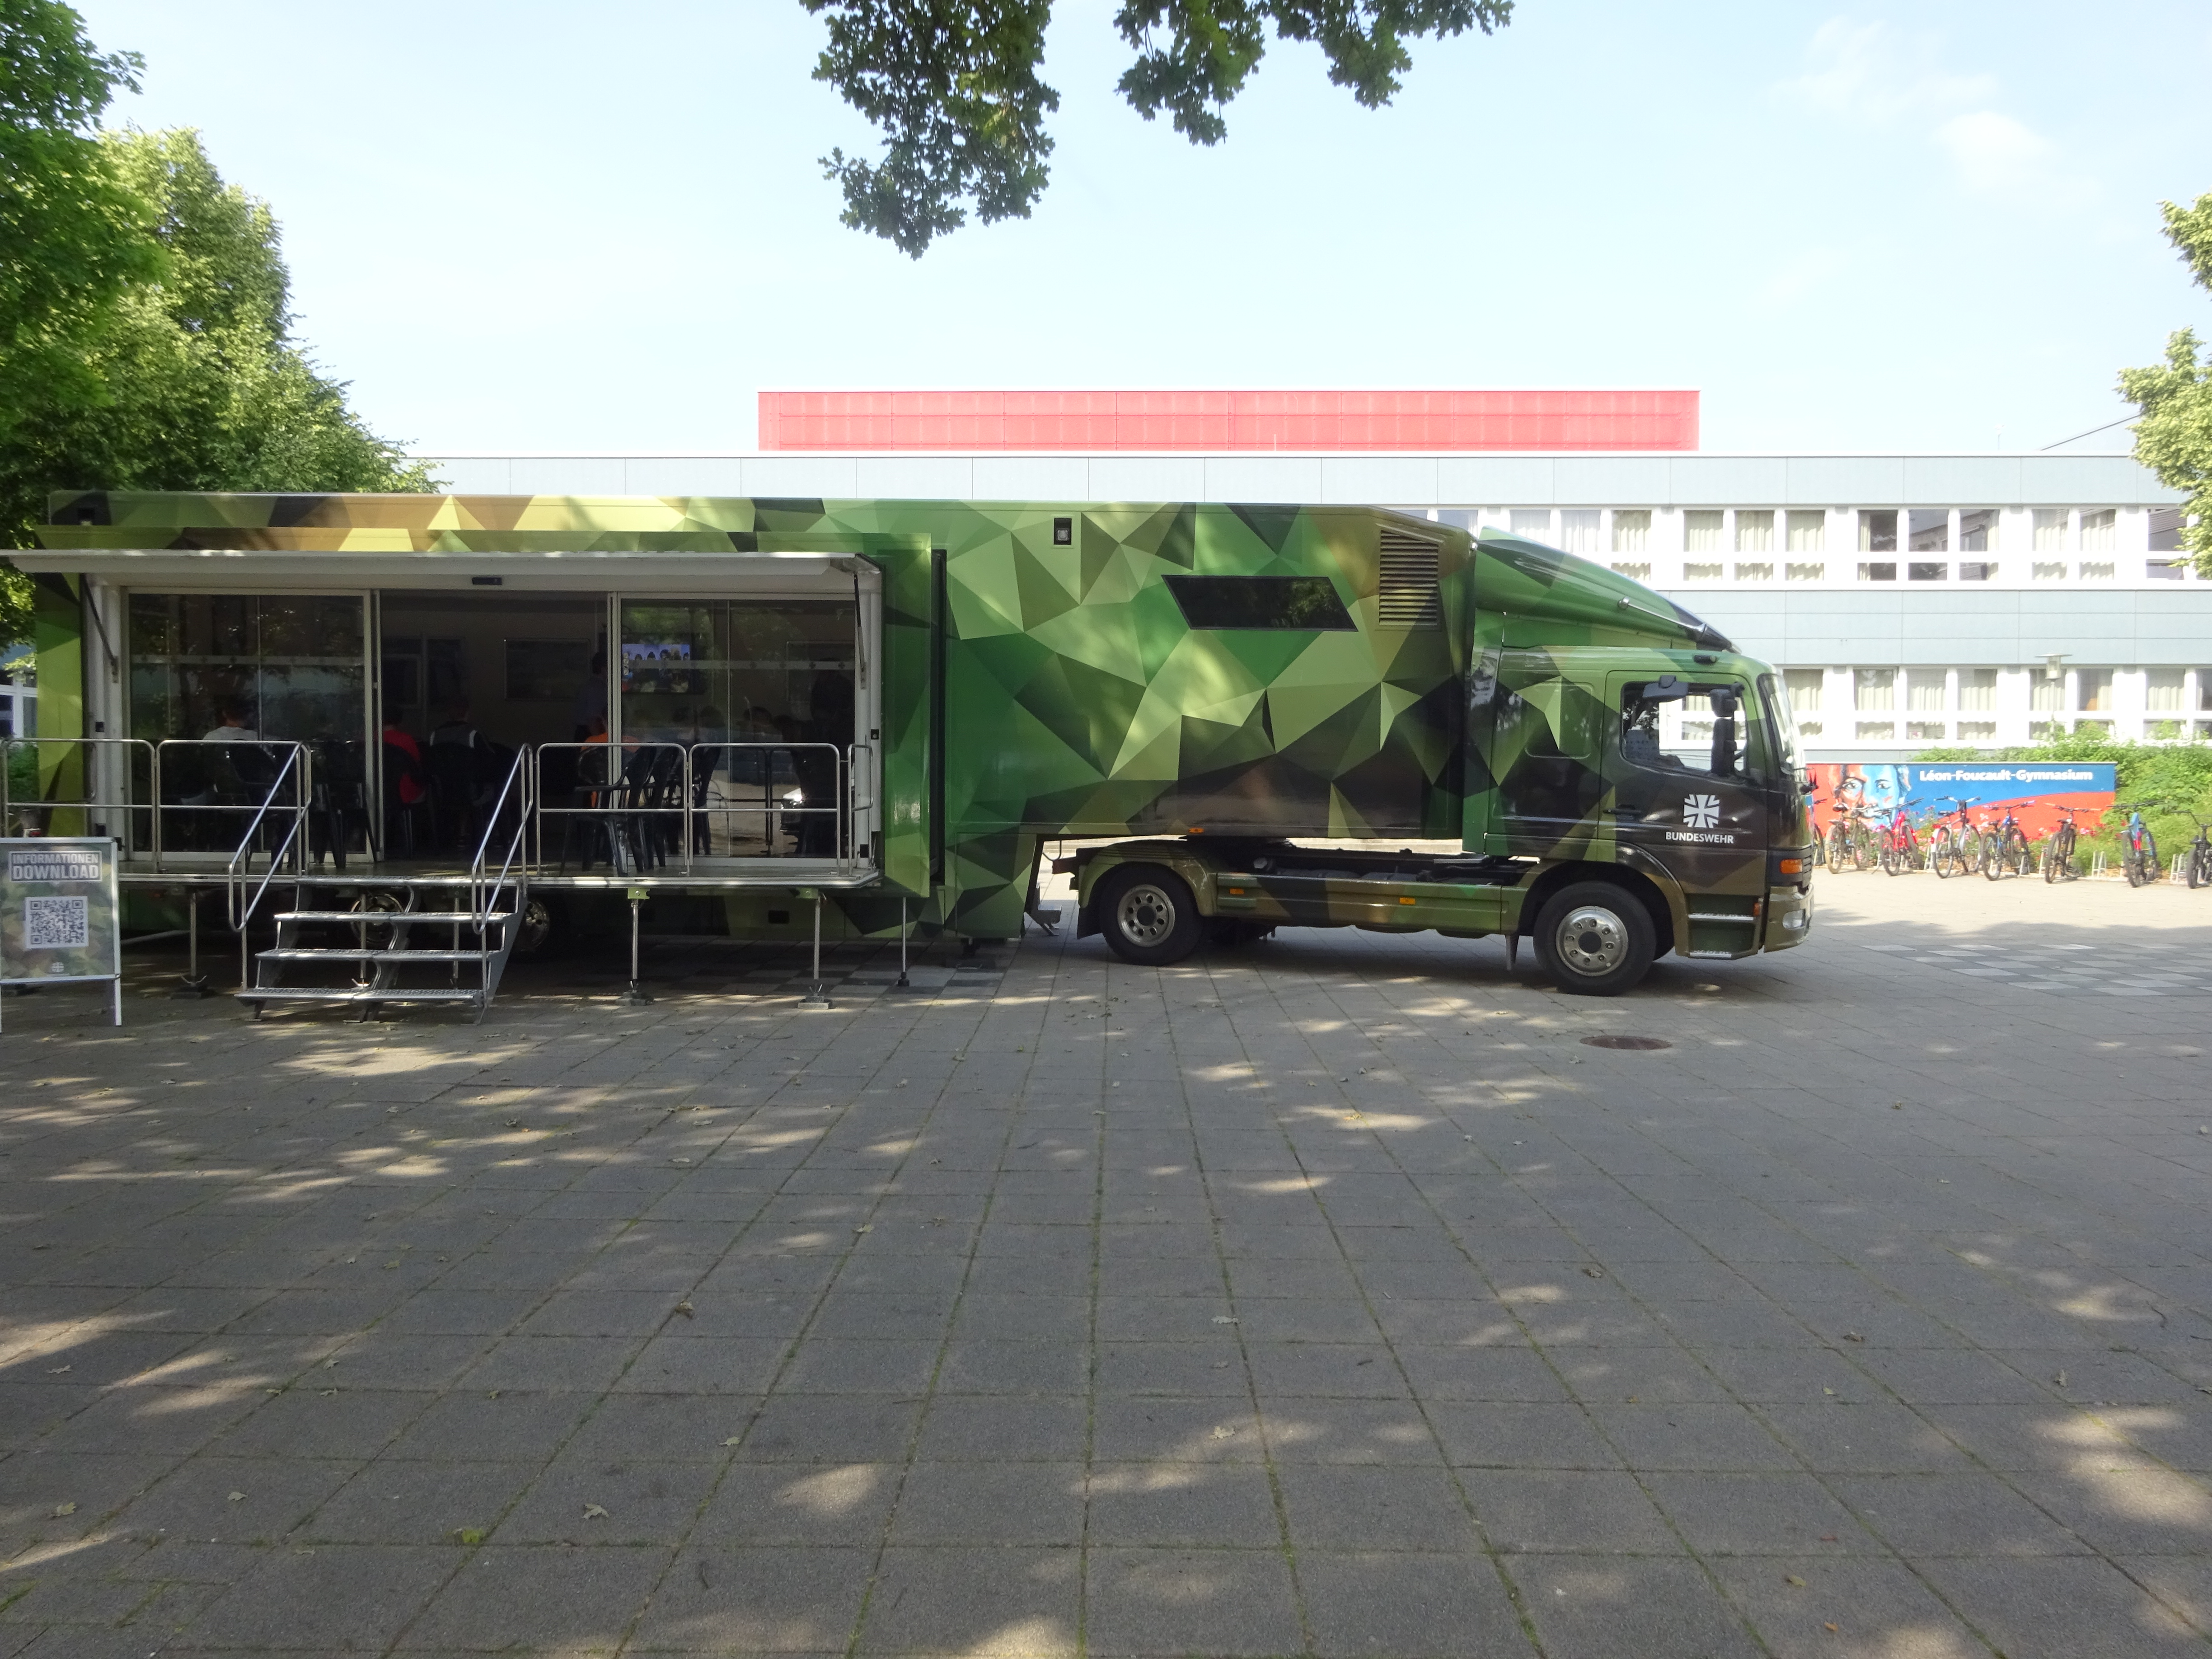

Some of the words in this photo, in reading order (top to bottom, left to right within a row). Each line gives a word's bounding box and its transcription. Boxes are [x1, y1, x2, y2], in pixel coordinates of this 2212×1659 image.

[1920, 769, 2093, 782] Léon-Foucault-Gymnasium
[1665, 832, 1734, 844] BUNDESWEHR
[13, 853, 98, 864] INFORMATIONEN
[13, 865, 99, 879] DOWNLOAD
